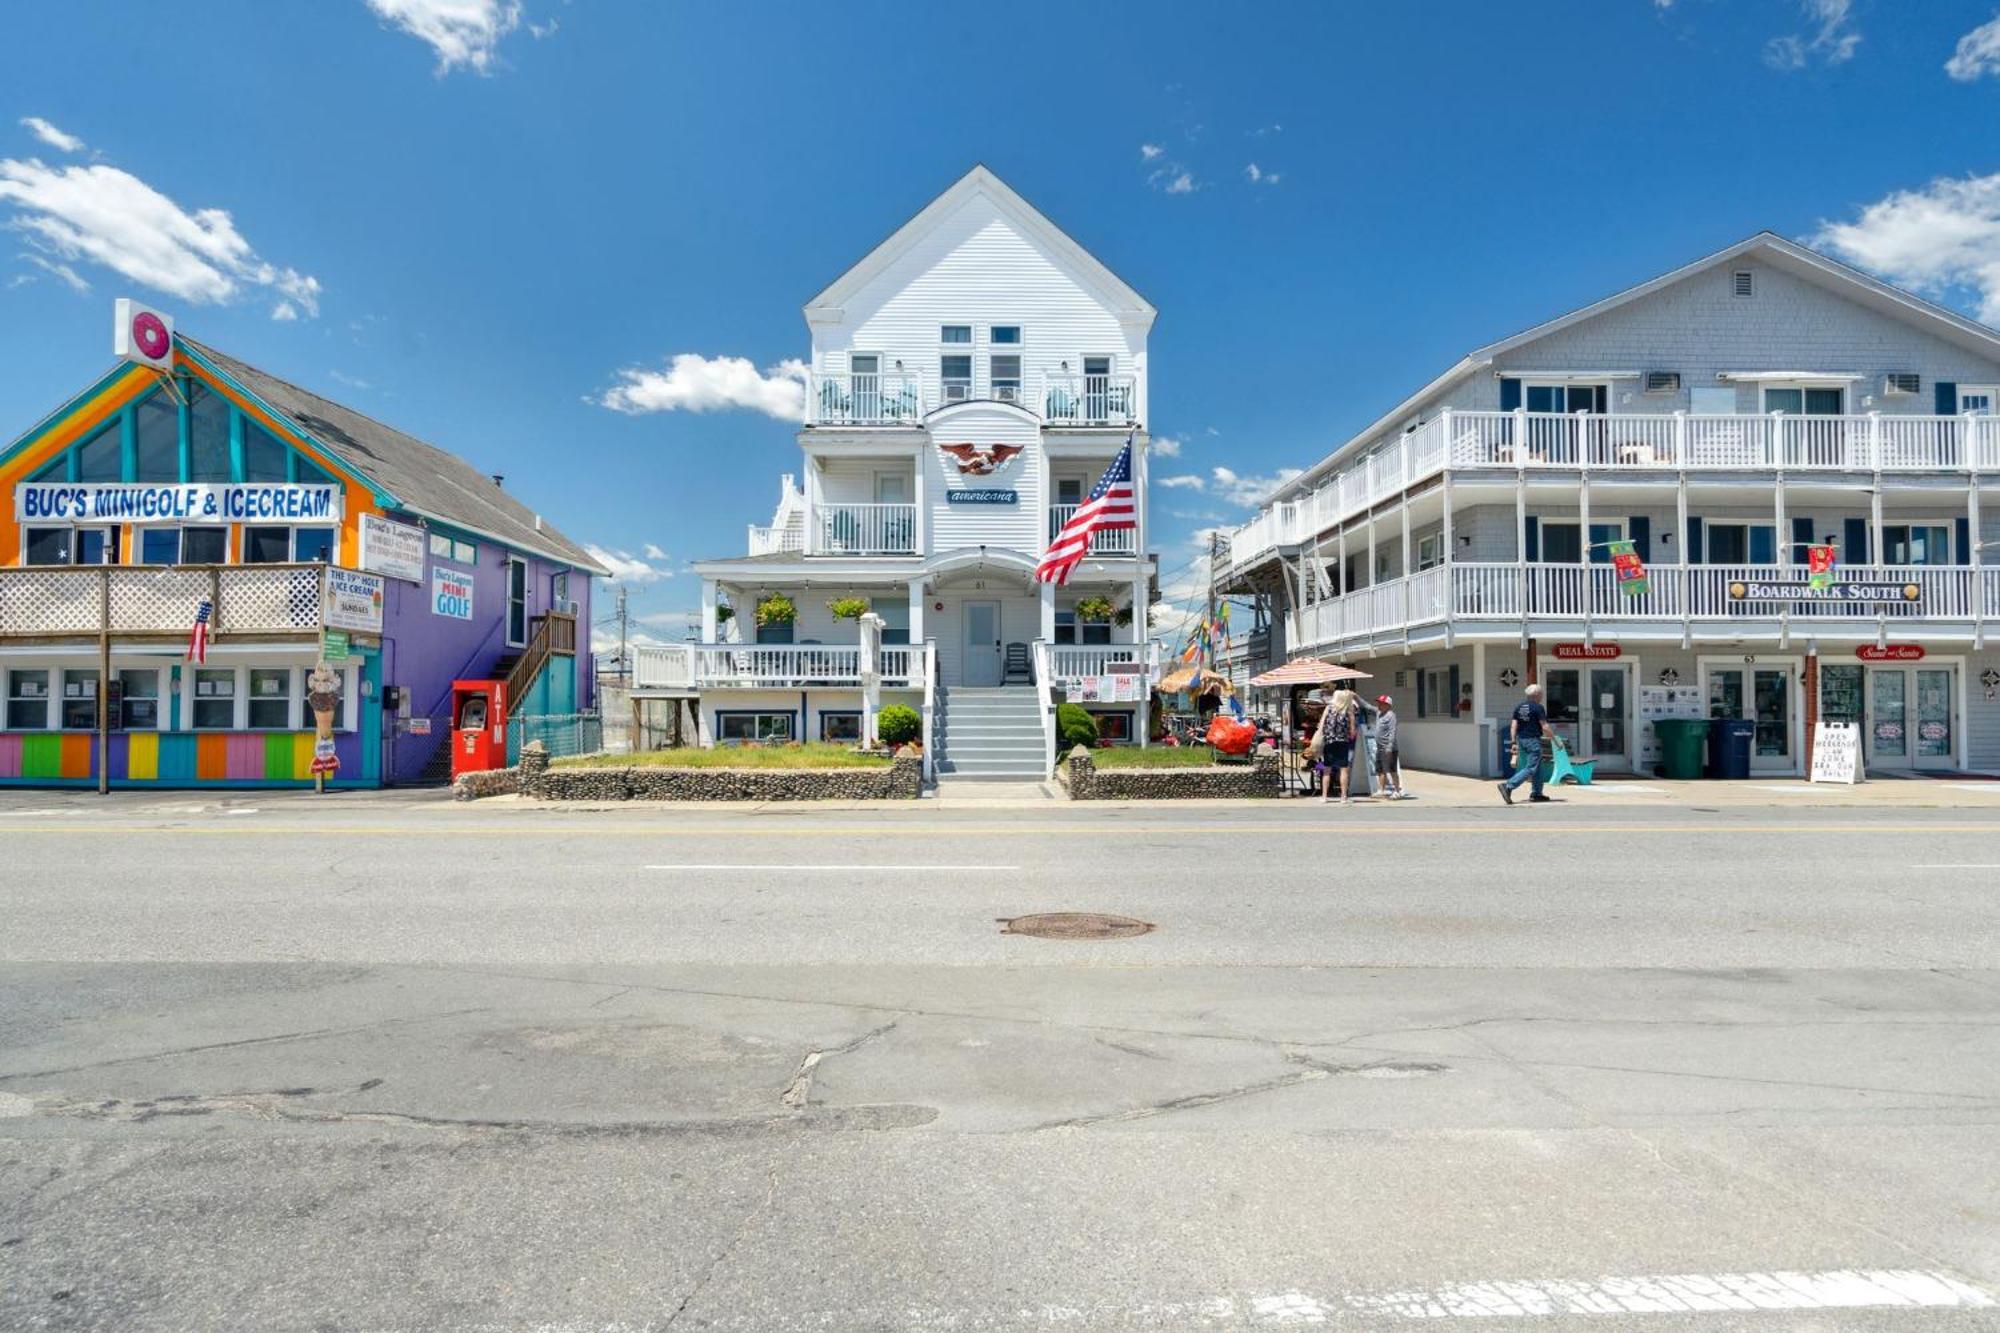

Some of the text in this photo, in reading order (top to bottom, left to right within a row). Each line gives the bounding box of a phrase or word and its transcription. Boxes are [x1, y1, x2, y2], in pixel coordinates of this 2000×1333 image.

[25, 488, 331, 518] BUC'S MINIGOLF & ICECREAM
[331, 570, 345, 581] THE
[362, 576, 379, 588] HOLE
[336, 582, 348, 592] ICE
[349, 584, 374, 597] CREAM
[443, 582, 465, 598] MINI
[1848, 584, 1901, 600] SOUTH
[437, 594, 470, 617] GOLF
[1559, 647, 1616, 656] REAL ESTATE
[1744, 655, 1755, 664] 63
